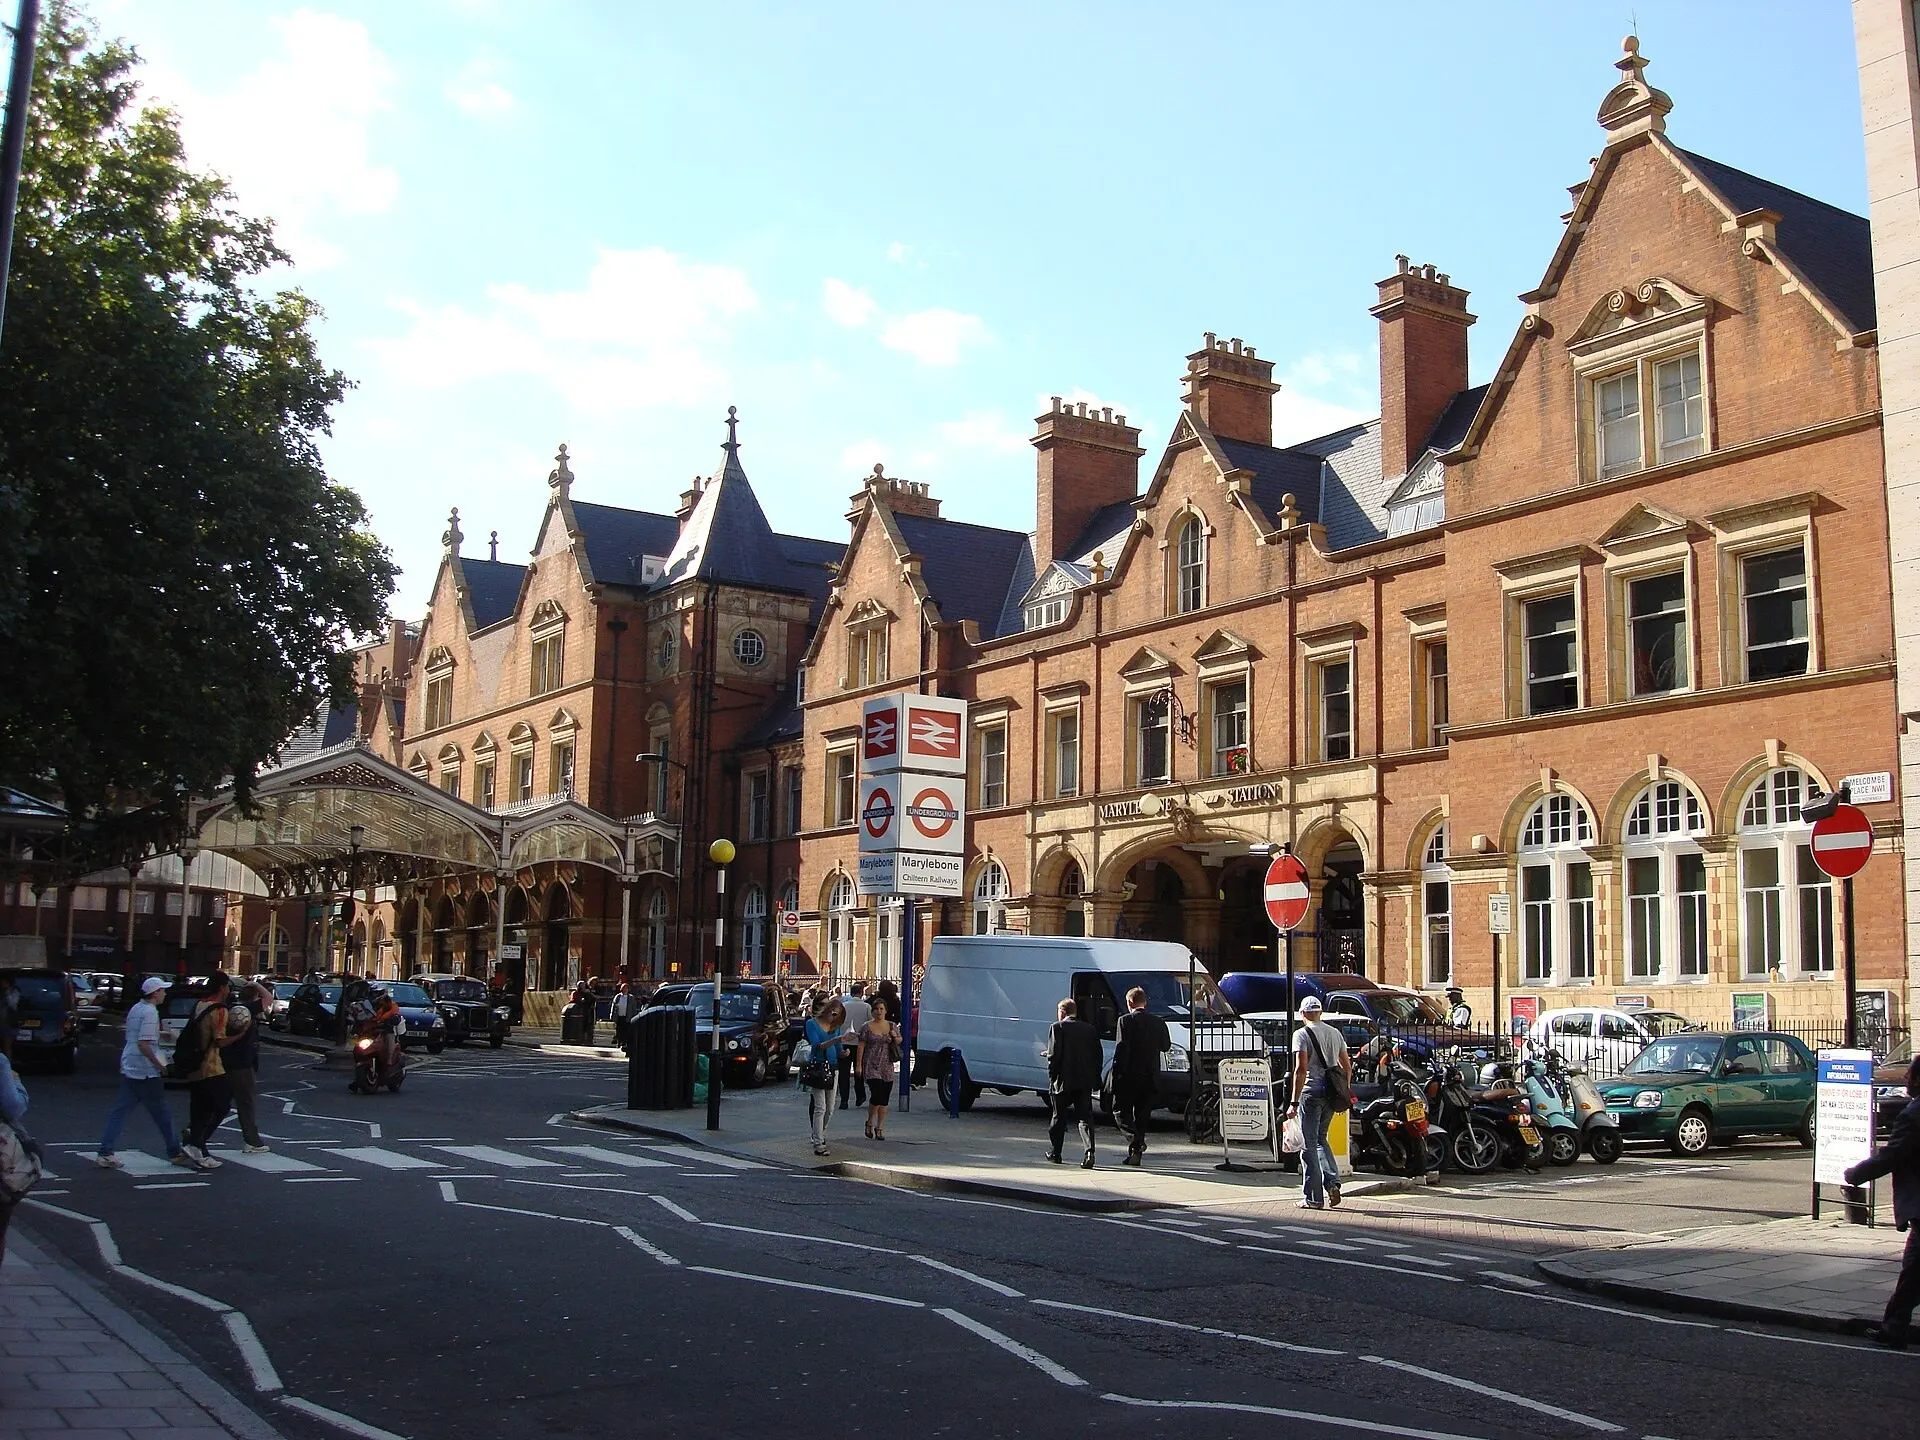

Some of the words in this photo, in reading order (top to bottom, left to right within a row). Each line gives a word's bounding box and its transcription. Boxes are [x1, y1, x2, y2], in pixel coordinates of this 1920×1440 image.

[1850, 775, 1885, 786] MELCOMBE
[1228, 782, 1278, 804] STATION
[1851, 786, 1869, 794] PLACE
[1872, 784, 1885, 792] NW1
[864, 808, 894, 818] UNDERGROUND
[909, 807, 956, 819] UNDERGROUND
[1099, 797, 1172, 819] MARYLENE
[860, 858, 894, 870] Marylebone
[902, 856, 959, 870] Marylebone
[860, 874, 875, 883] Chiltern
[876, 874, 892, 883] Railways
[902, 873, 928, 883] Chiltern
[930, 875, 958, 885] Railways
